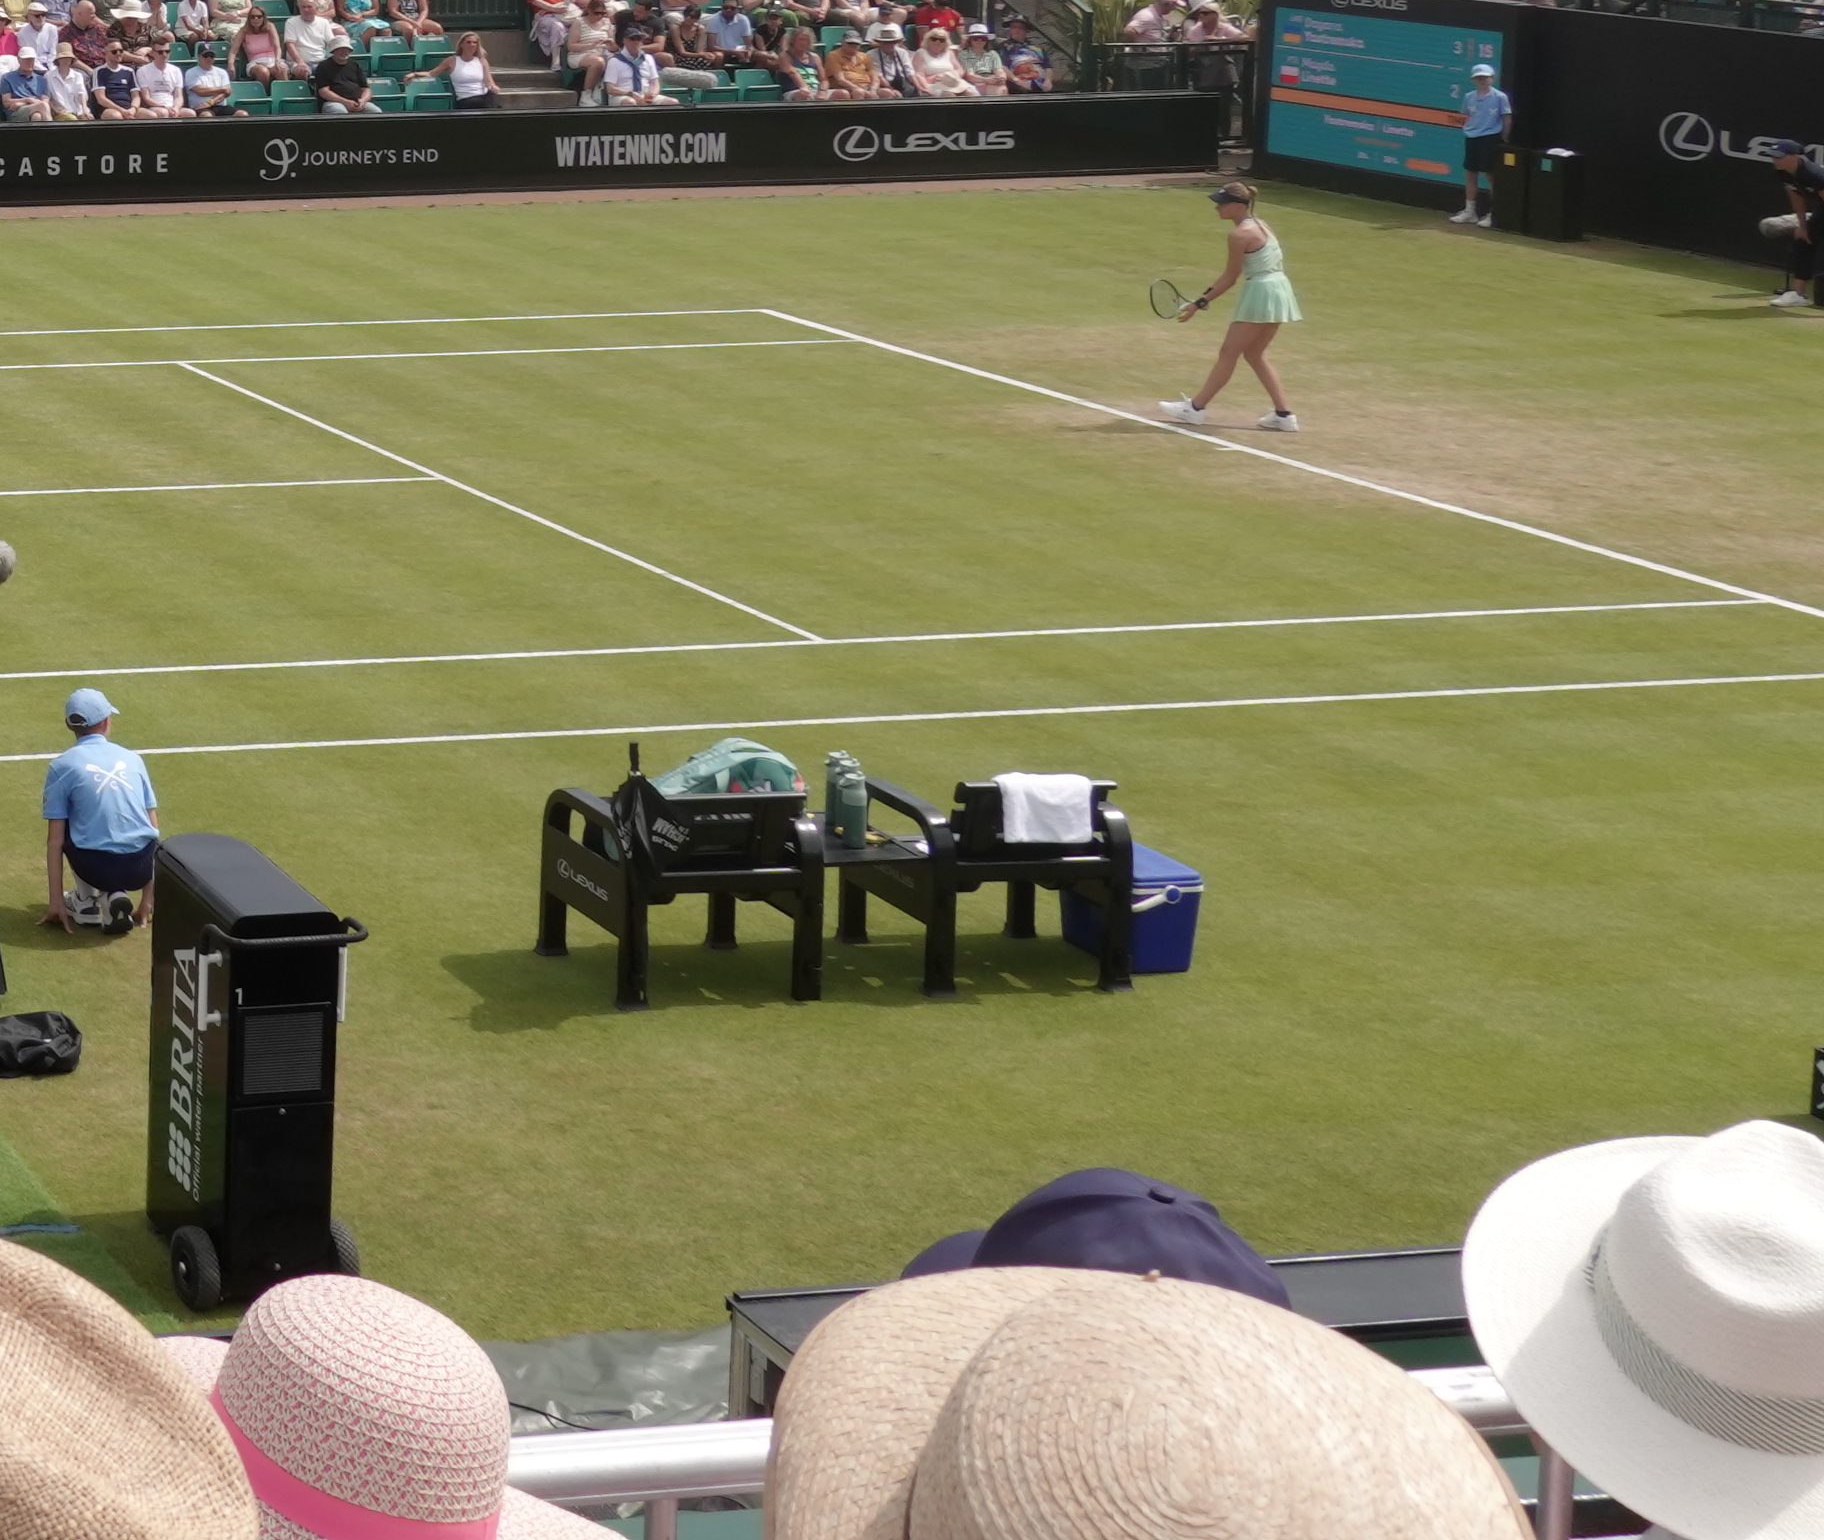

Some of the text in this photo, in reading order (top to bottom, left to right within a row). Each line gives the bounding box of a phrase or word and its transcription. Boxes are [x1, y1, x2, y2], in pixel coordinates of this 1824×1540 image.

[1453, 41, 1463, 54] 3
[1478, 44, 1494, 58] 15
[1450, 84, 1459, 98] 2
[554, 131, 727, 168] WTATENNIS.COM
[883, 130, 1016, 152] LEXUS
[302, 148, 439, 166] JOURNEY'S END
[570, 868, 609, 902] LEXUS
[235, 987, 243, 1005] 1
[170, 946, 196, 1130] BRITA
[192, 1035, 204, 1204] Official water partner
